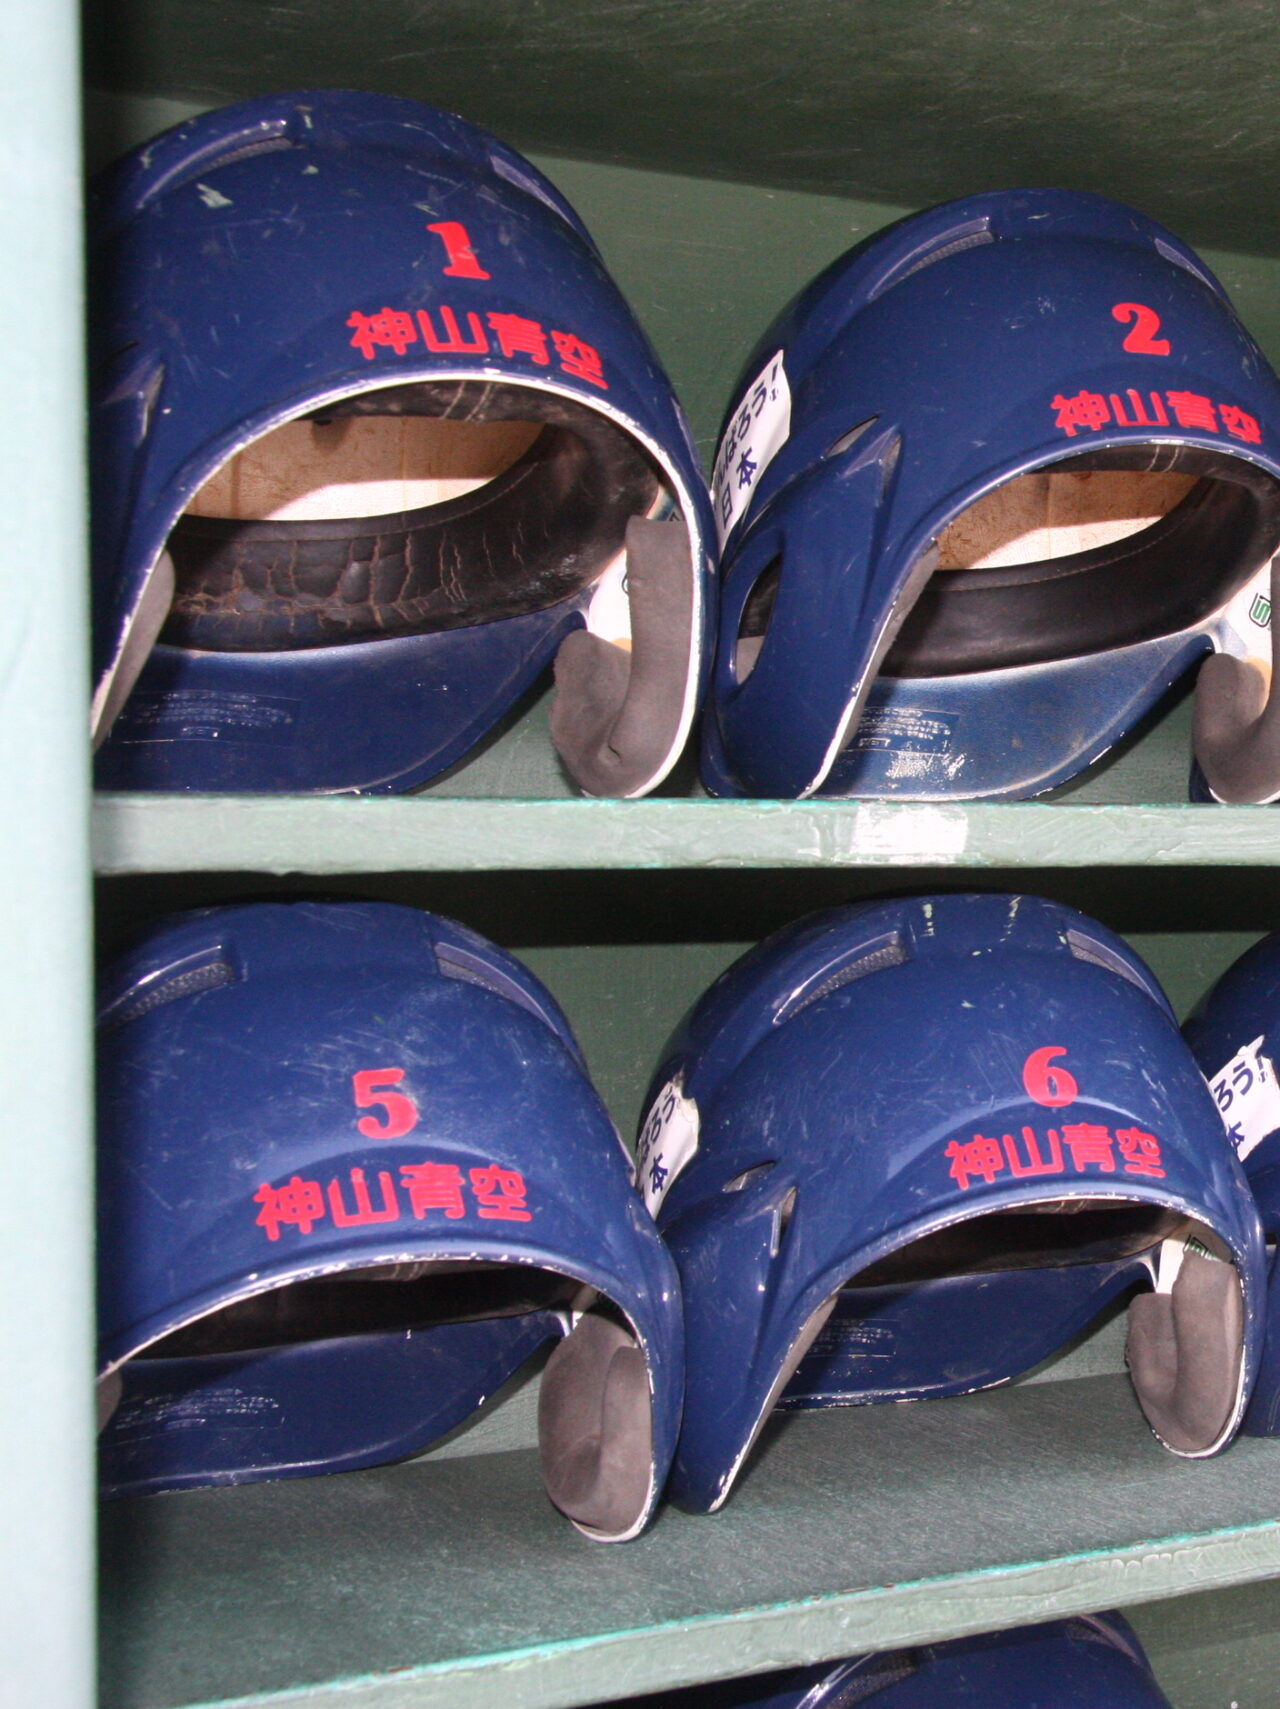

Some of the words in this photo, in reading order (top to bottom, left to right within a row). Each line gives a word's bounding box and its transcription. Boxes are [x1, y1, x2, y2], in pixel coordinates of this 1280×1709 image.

[426, 220, 492, 281] 1
[345, 305, 609, 390] 神山青空
[1111, 302, 1171, 356] 2
[1049, 388, 1262, 445] 神山青空
[721, 447, 758, 529] 日本
[352, 1068, 418, 1139] 5
[1022, 1045, 1079, 1108] 6
[943, 1122, 1167, 1190] 神山青空
[252, 1161, 533, 1241] 神山青空
